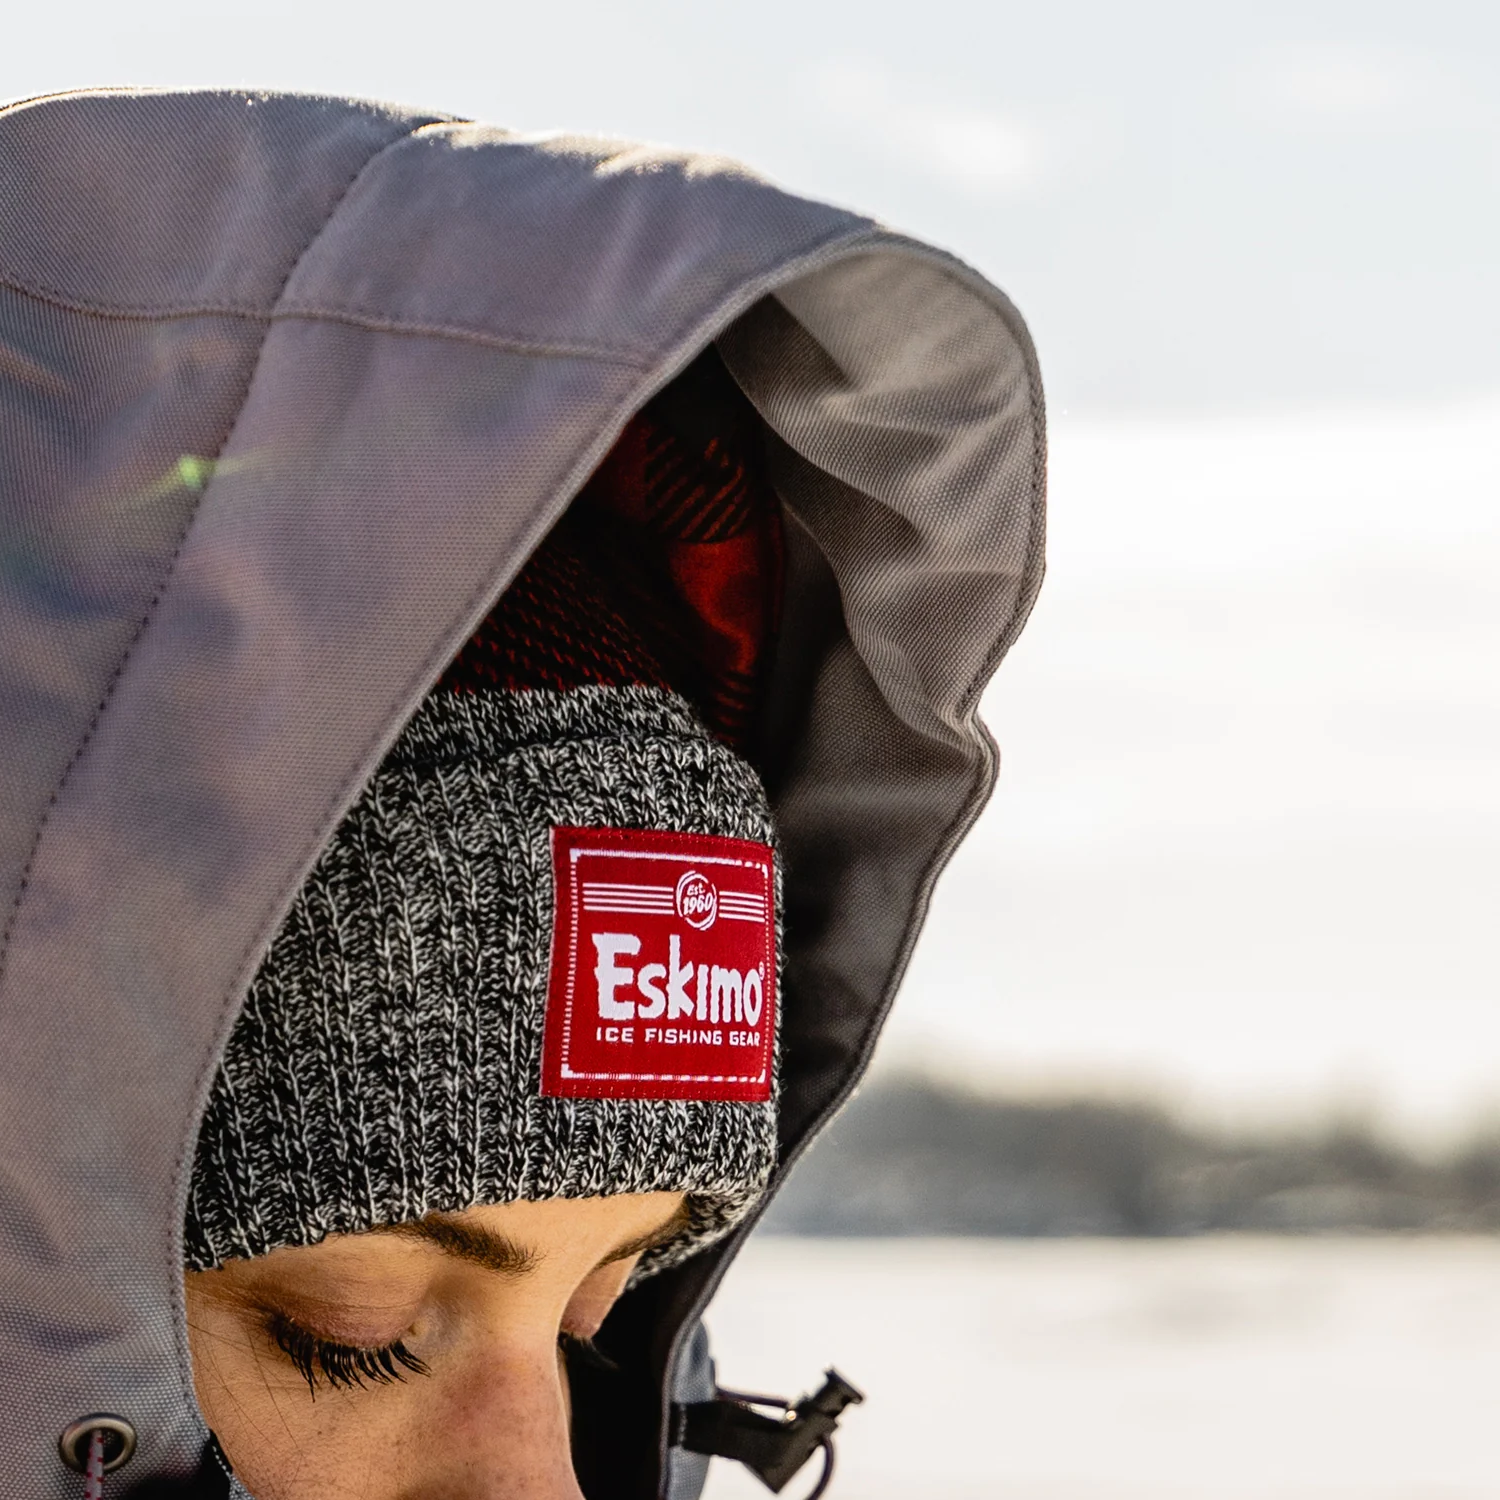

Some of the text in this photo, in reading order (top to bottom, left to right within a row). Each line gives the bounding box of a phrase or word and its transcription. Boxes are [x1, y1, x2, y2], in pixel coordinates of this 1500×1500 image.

[683, 893, 713, 915] 1960
[592, 932, 763, 1026] Eskimo
[596, 1027, 760, 1046] ICE FISHING GEAR
